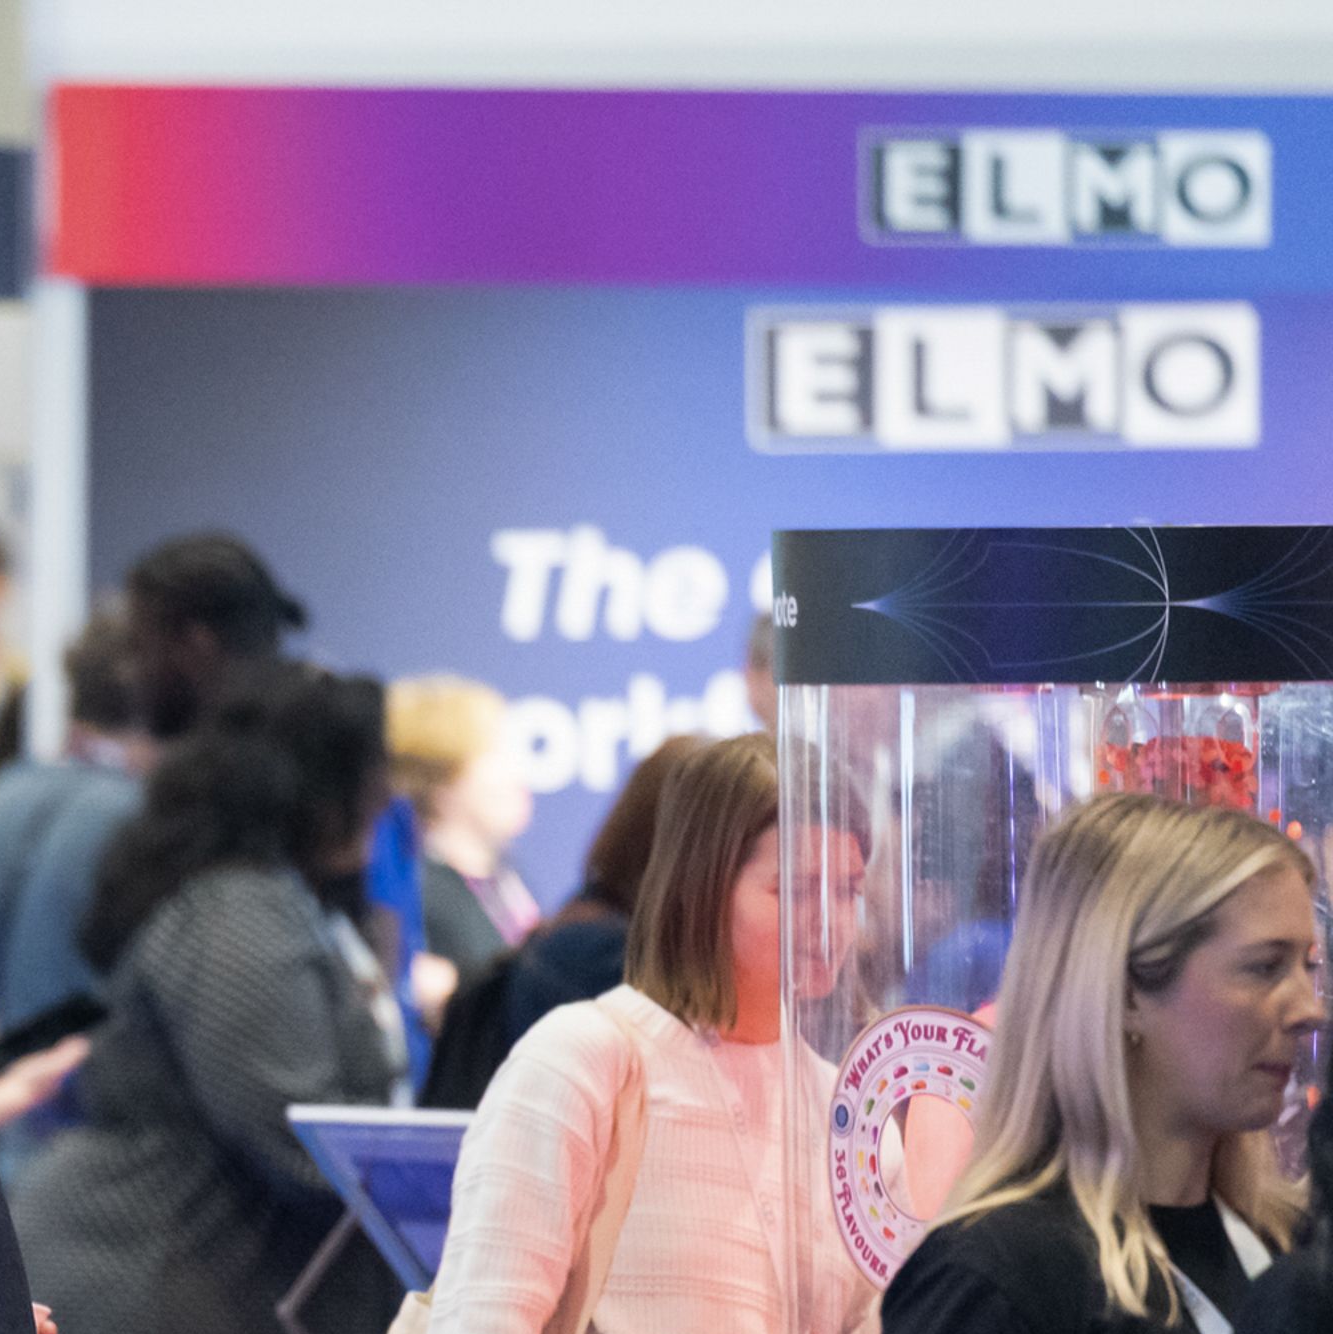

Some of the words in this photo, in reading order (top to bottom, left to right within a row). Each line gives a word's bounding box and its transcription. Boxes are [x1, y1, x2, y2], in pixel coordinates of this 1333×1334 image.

[871, 128, 1271, 249] ELMO
[765, 304, 1261, 450] ELMO
[490, 522, 729, 643] The
[773, 590, 798, 628] ote
[952, 1026, 987, 1063] FLA
